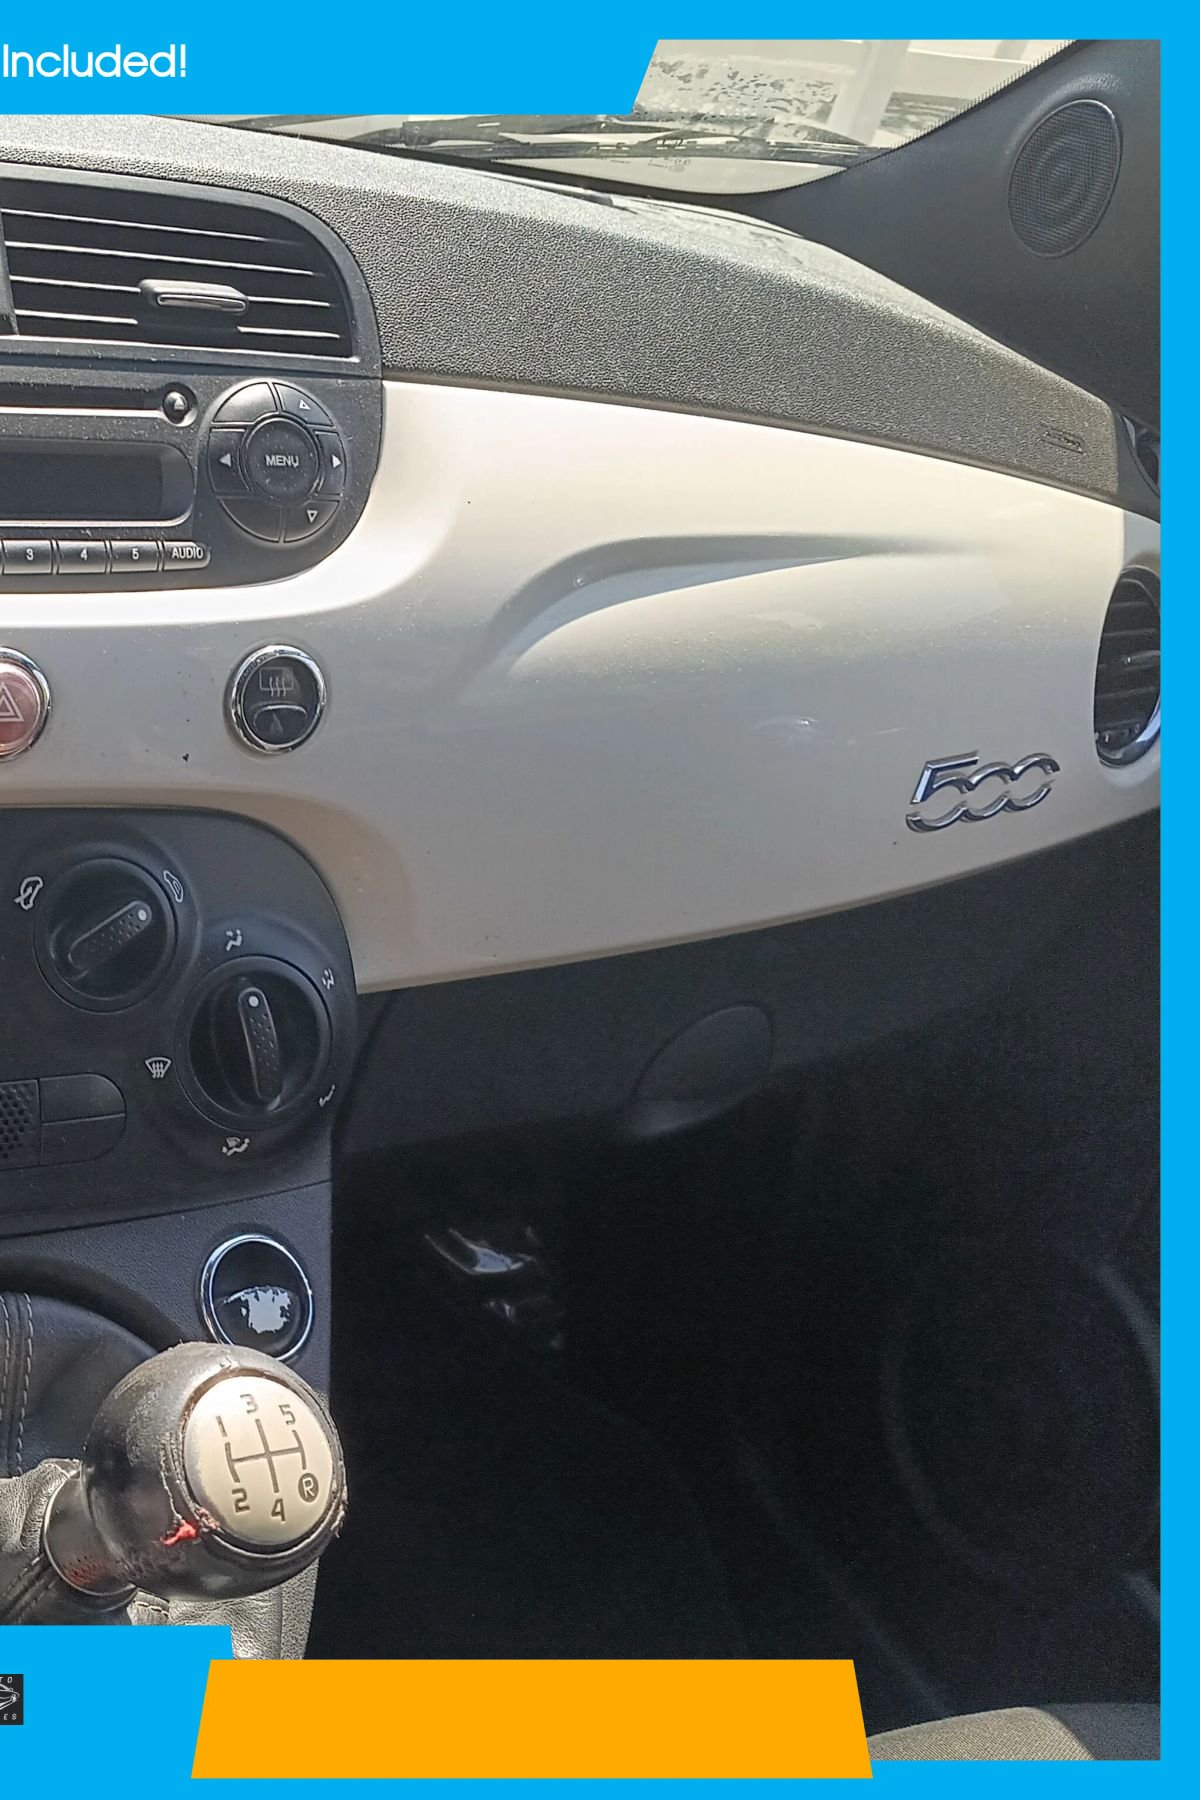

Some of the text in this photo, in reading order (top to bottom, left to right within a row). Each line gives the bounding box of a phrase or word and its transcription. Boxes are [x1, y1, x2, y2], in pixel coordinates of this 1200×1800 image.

[265, 454, 299, 468] MENU
[25, 548, 35, 560] 3
[79, 548, 89, 561] 4
[131, 547, 140, 560] 5
[171, 547, 204, 559] AUDIO
[906, 750, 1060, 833] 500
[239, 1393, 259, 1415] 3
[279, 1404, 297, 1426] 5
[301, 1476, 317, 1500] R
[231, 1487, 251, 1513] 2
[270, 1497, 287, 1523] 4
